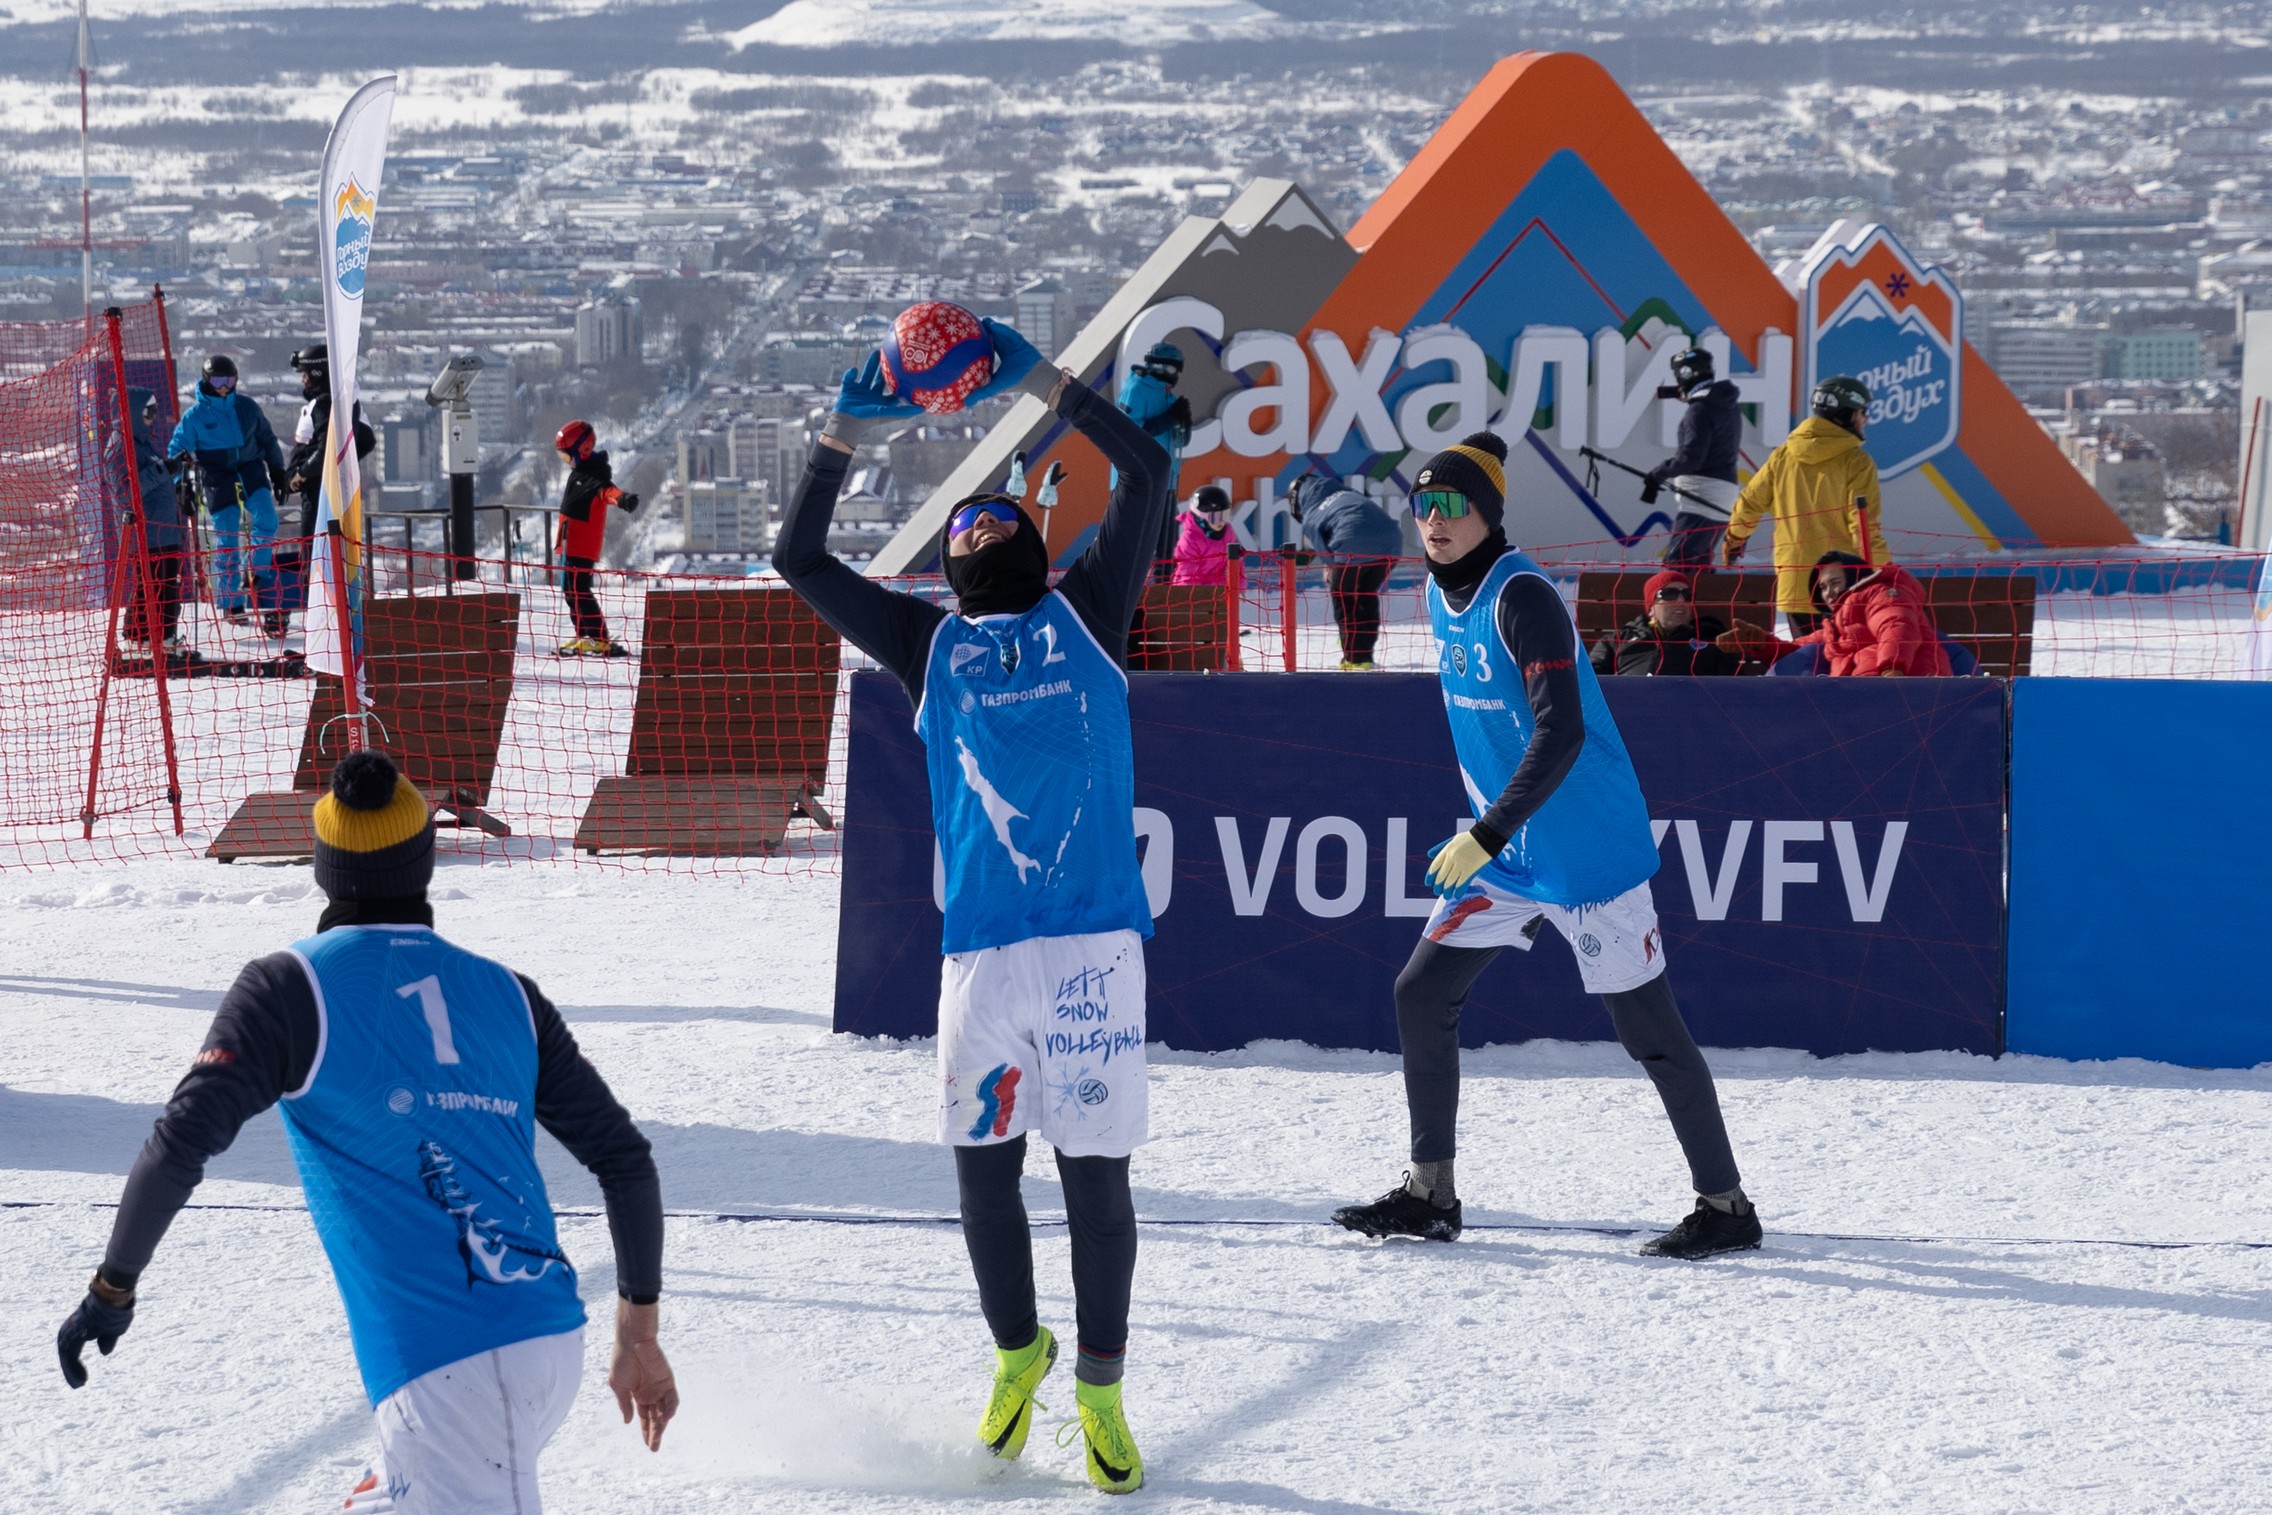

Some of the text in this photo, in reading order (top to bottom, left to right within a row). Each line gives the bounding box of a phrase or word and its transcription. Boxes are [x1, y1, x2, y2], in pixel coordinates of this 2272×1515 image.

[338, 251, 368, 279] возду
[1115, 296, 1794, 458] Сахалин
[1856, 344, 1933, 393] рный
[1866, 378, 1946, 425] здух
[1032, 622, 1067, 668] 2
[1473, 642, 1493, 683] 3
[981, 679, 1073, 708] ГАЗПРОМБАНК
[1214, 815, 1909, 923] VOLVFV
[395, 974, 460, 1065] 1
[1056, 1001, 1109, 1023] SNOW
